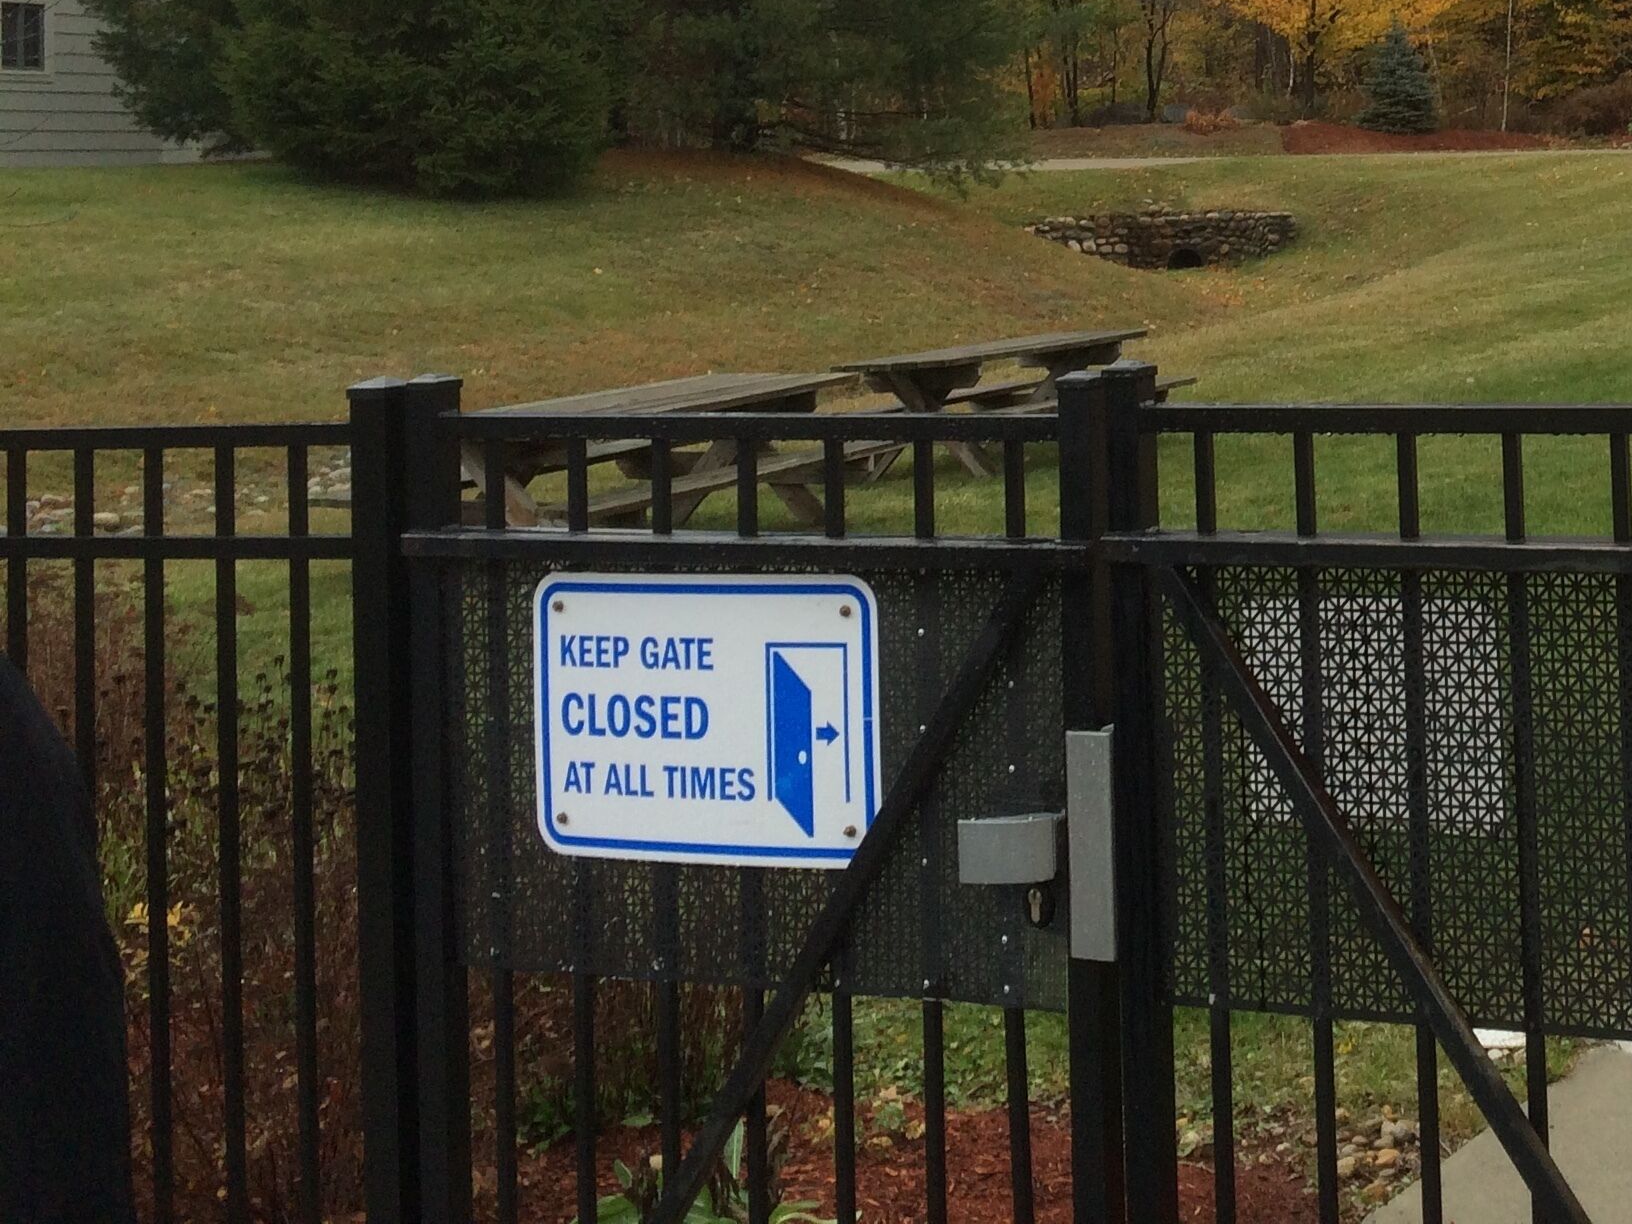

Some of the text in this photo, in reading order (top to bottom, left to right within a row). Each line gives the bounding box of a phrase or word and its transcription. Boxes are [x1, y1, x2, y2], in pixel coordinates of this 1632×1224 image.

[559, 634, 714, 671] KEEP GATE
[561, 692, 710, 740] CLOSED
[564, 760, 756, 802] AT ALL TIMES
